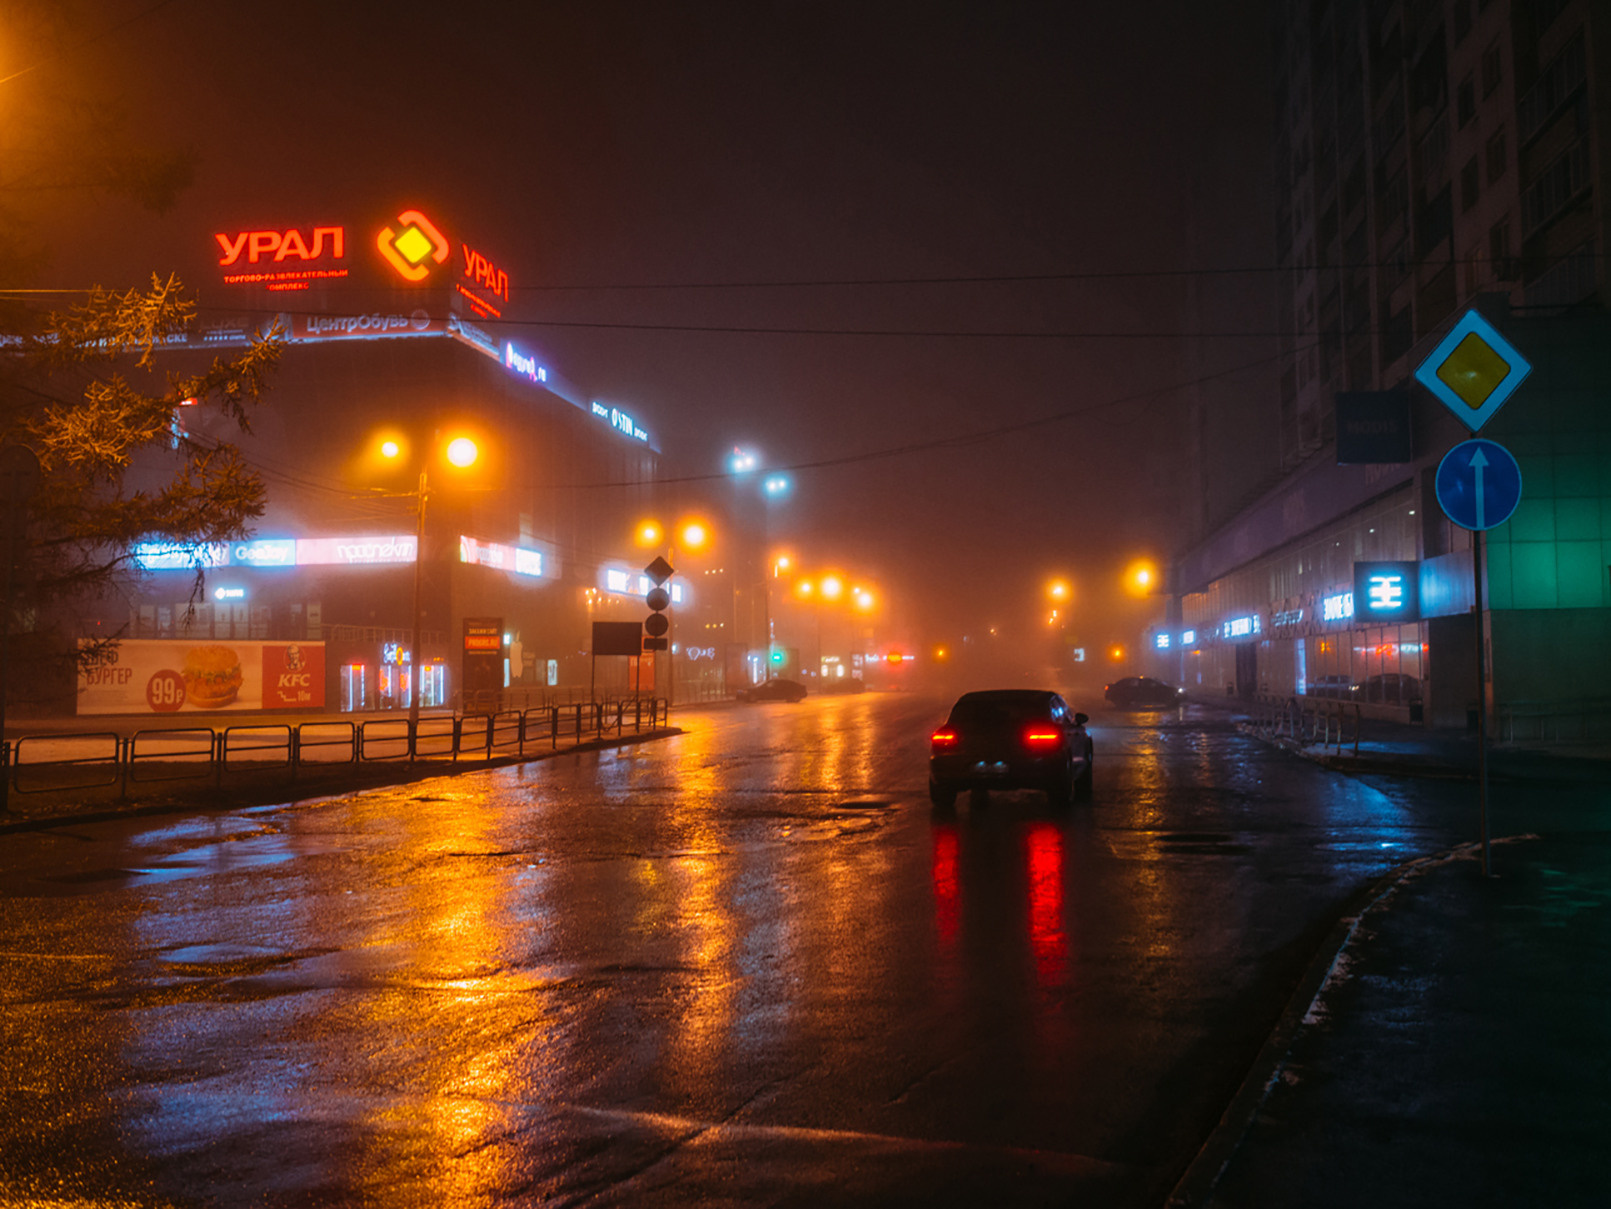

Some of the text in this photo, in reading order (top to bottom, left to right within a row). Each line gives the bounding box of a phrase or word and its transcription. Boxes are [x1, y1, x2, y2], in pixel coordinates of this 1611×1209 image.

[214, 226, 344, 266] УРАЛ
[463, 243, 509, 303] УРАЛ
[266, 282, 309, 292] ОМПЛЕКС
[306, 312, 409, 335] ЦентрОбувь
[86, 667, 133, 686] БУРГЕР
[277, 673, 311, 687] KFC
